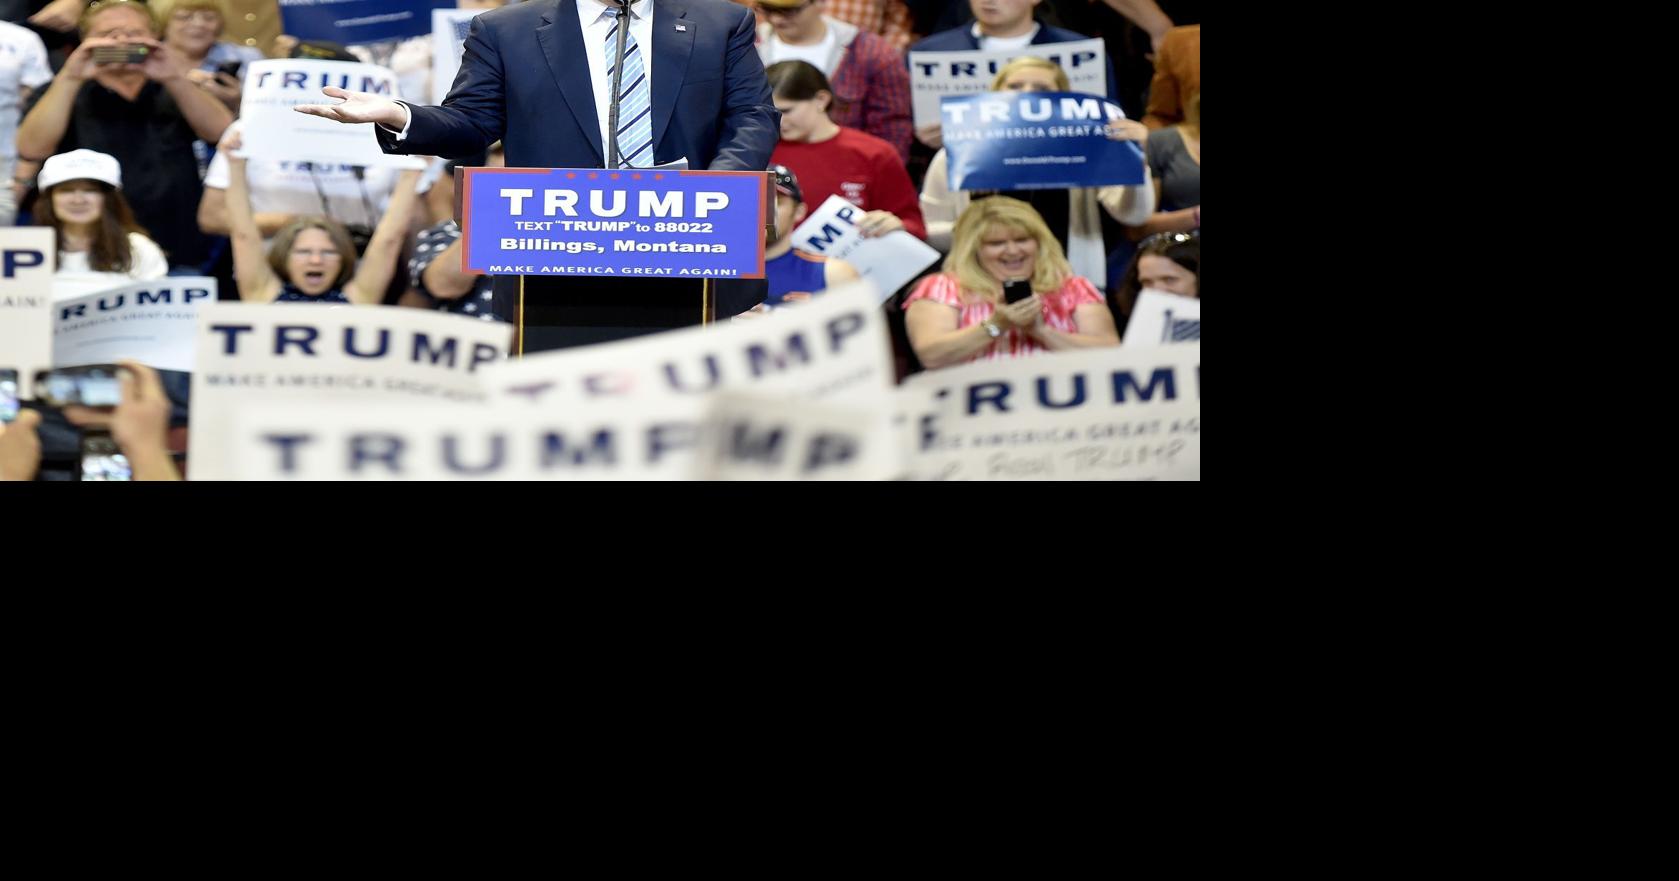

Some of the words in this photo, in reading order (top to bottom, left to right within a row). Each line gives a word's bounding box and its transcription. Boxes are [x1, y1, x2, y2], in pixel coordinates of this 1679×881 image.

[915, 51, 1096, 77] TRP
[1048, 124, 1090, 138] GREAT
[500, 188, 729, 218] TRUMP
[515, 221, 552, 231] TEXT
[655, 222, 713, 233] 88022
[500, 238, 605, 253] Billings,
[614, 239, 728, 254] Montana
[489, 265, 534, 273] MAKE
[541, 266, 615, 274] AMERICA
[621, 267, 672, 275] GREAT
[679, 268, 737, 276] AGAIN!
[60, 288, 209, 321] RUMP
[209, 325, 499, 373] TRUMP
[936, 366, 1200, 416] RUM
[261, 421, 698, 476] TRUMP
